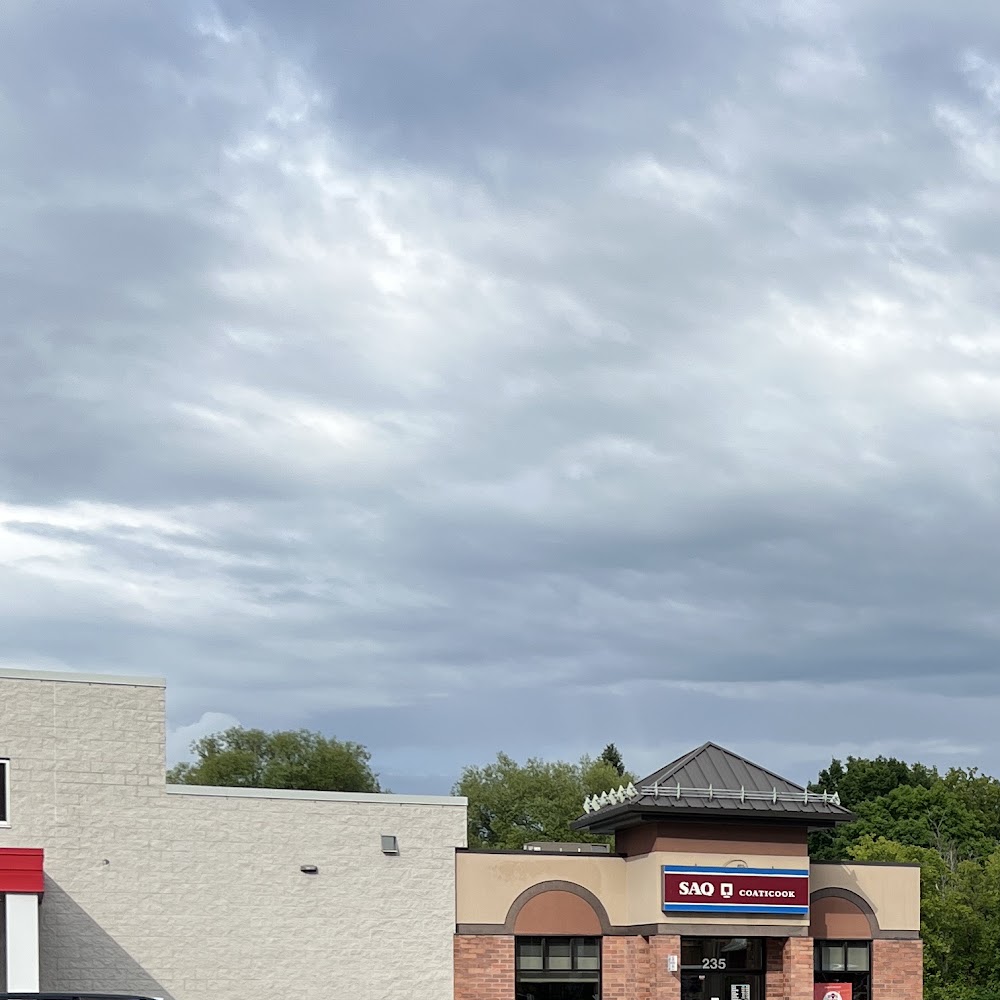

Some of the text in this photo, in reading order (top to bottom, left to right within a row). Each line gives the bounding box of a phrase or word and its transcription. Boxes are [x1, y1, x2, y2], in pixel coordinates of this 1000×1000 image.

[679, 881, 796, 898] SAQ COATICOOK
[702, 958, 727, 970] 235
